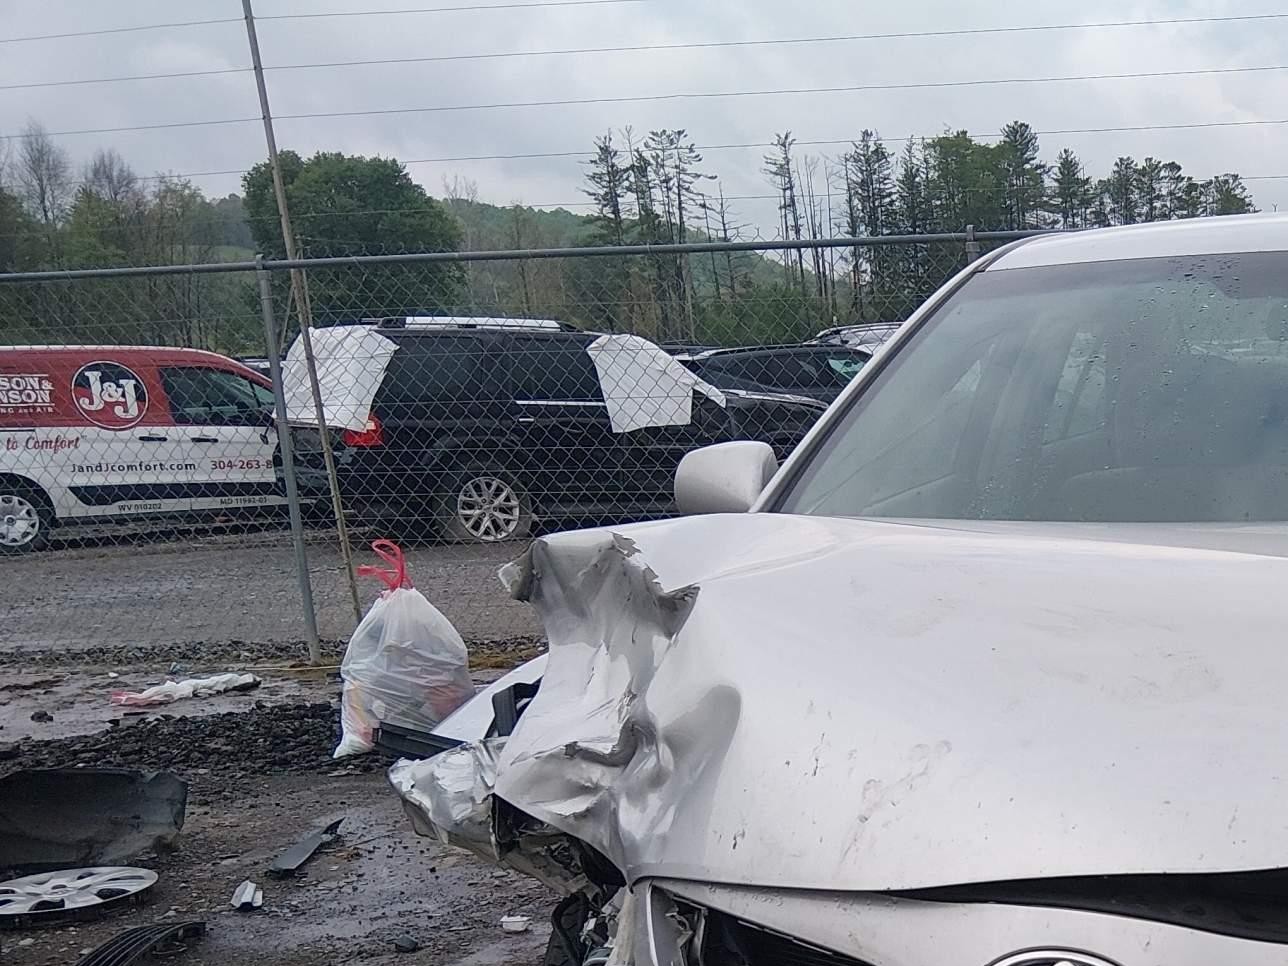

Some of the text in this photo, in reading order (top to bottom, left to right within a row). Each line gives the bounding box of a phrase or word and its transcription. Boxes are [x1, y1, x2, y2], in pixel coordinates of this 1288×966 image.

[80, 371, 139, 419] J&J
[6, 434, 80, 454] to Comfort
